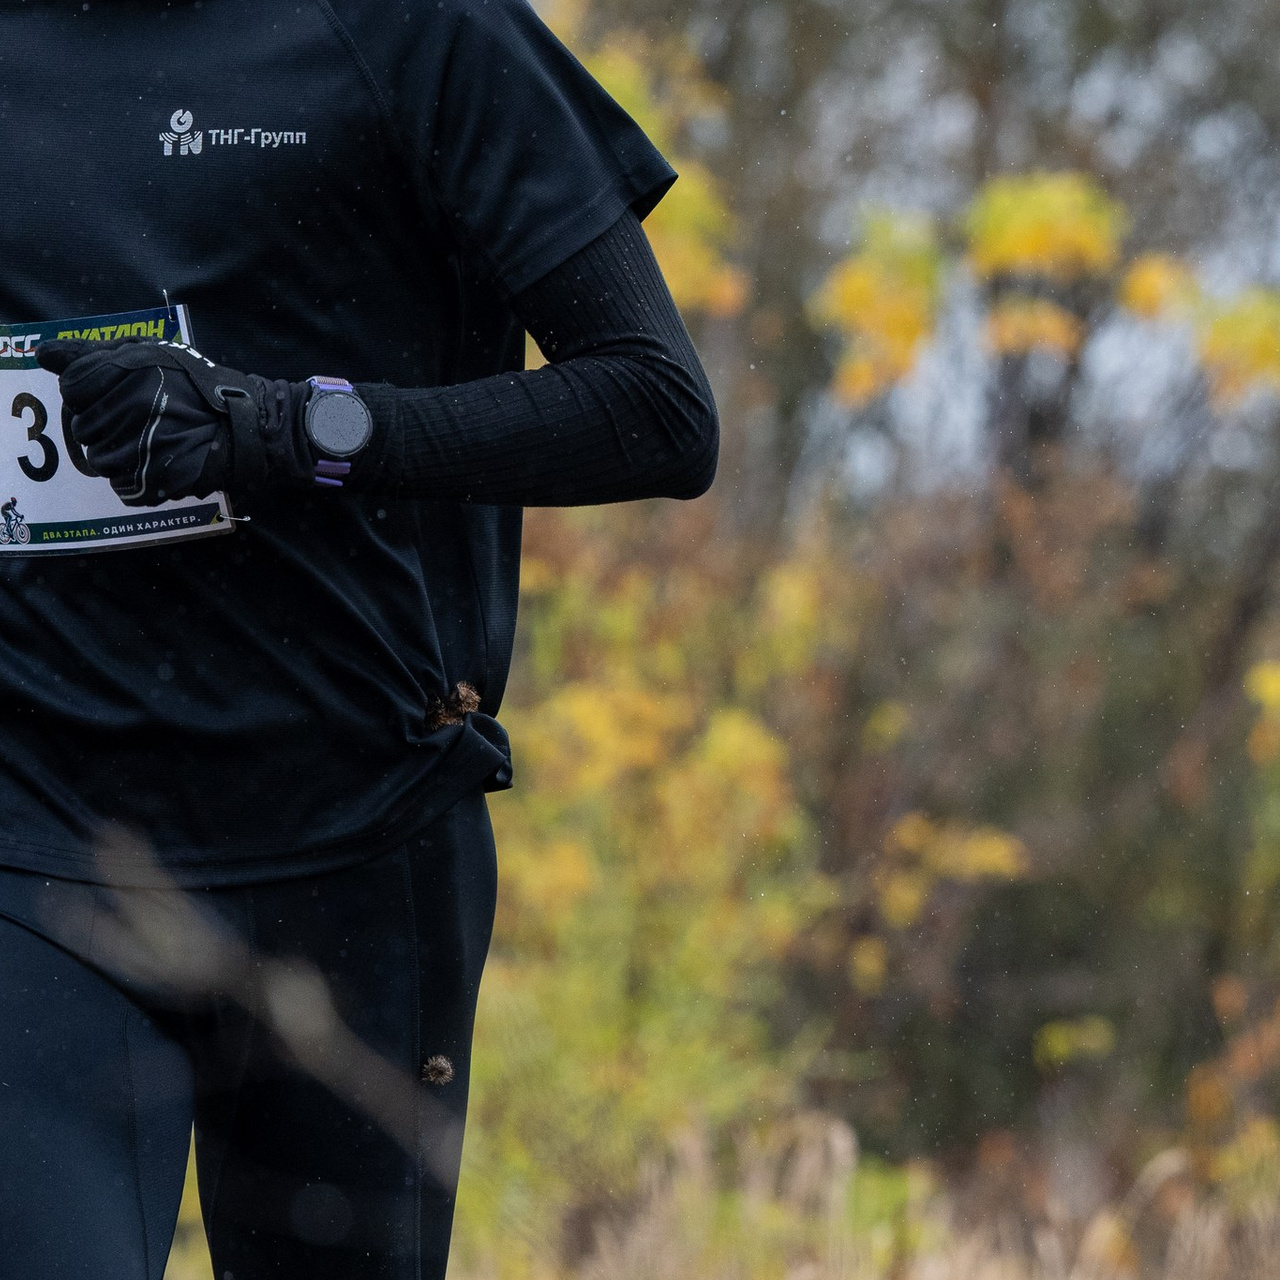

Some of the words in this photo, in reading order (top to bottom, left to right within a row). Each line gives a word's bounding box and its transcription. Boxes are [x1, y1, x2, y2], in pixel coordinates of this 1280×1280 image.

[208, 128, 307, 148] ТНГ-Групп
[42, 531, 62, 540] ДВА
[63, 528, 101, 538] ЭТАПА.
[103, 524, 134, 535] ОДИН
[136, 515, 201, 531] ХАРАКТЕР.
